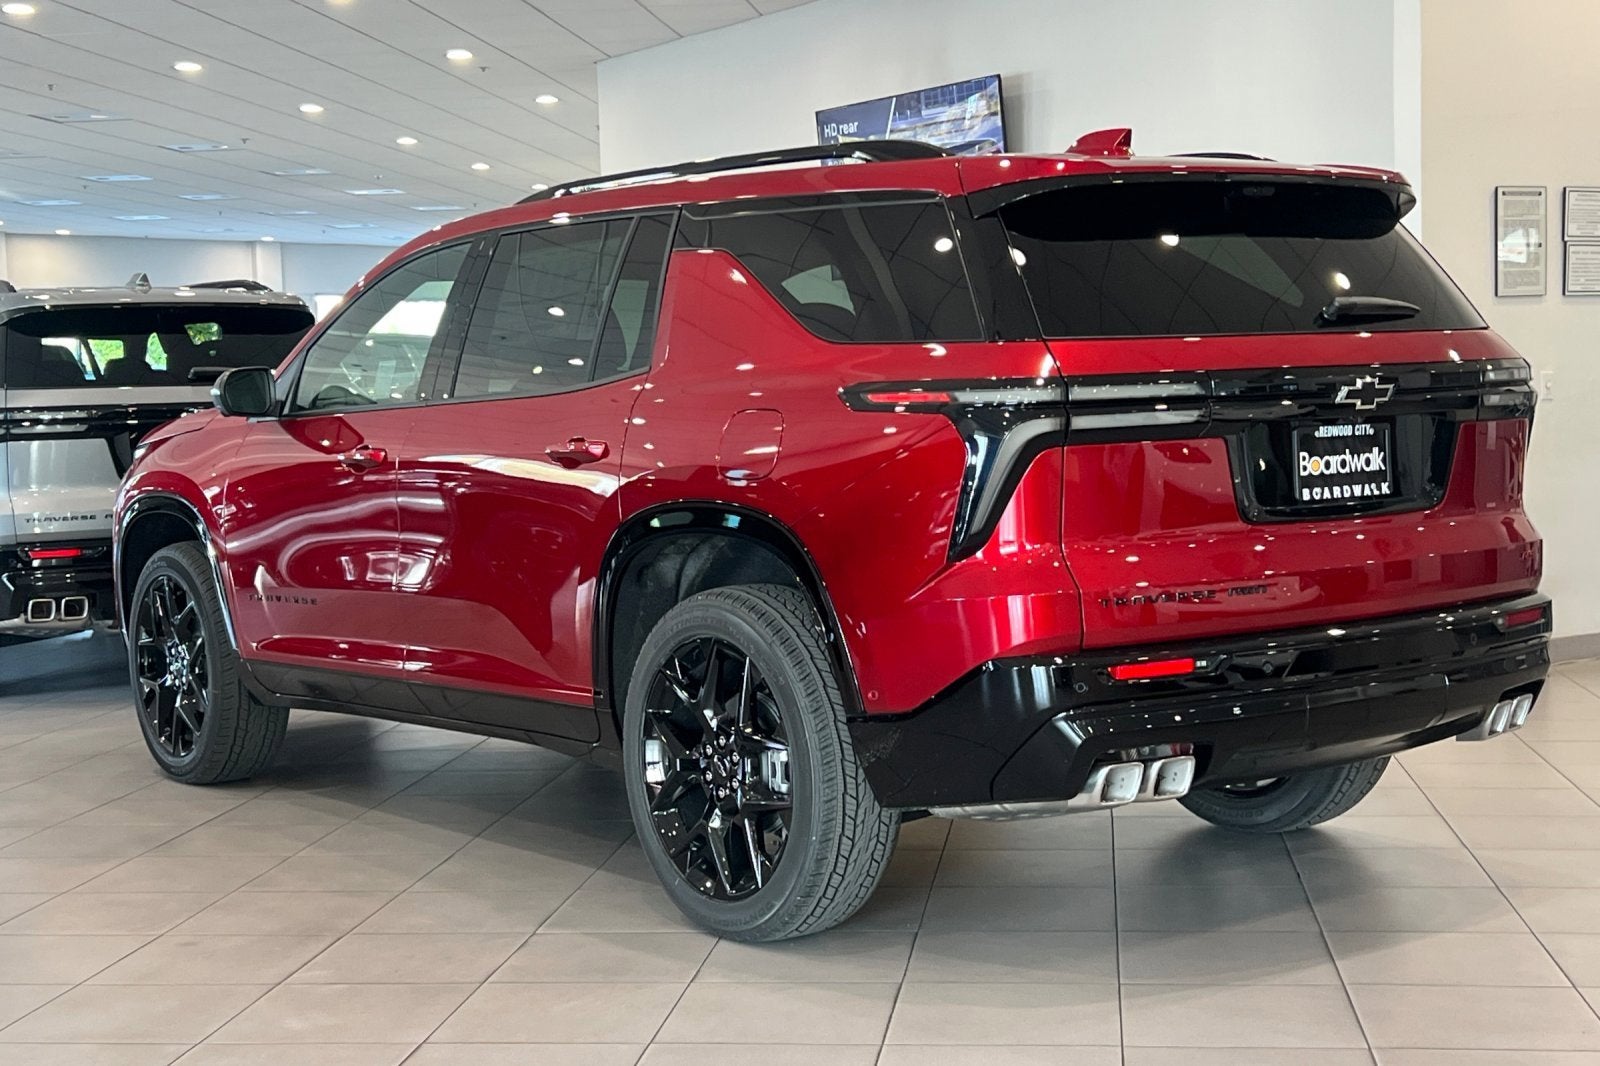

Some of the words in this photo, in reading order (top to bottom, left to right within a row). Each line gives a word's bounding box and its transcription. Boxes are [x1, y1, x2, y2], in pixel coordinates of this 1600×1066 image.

[824, 124, 837, 138] HD
[839, 121, 859, 135] rear
[1319, 425, 1352, 437] REDWOOD
[1354, 424, 1371, 436] CITY
[1299, 446, 1386, 477] Boardwalk
[1301, 482, 1391, 501] BOARDWALK
[24, 514, 97, 523] TRAVERSE
[248, 594, 318, 606] TRAVERSE
[1099, 589, 1217, 608] TRAVERSE
